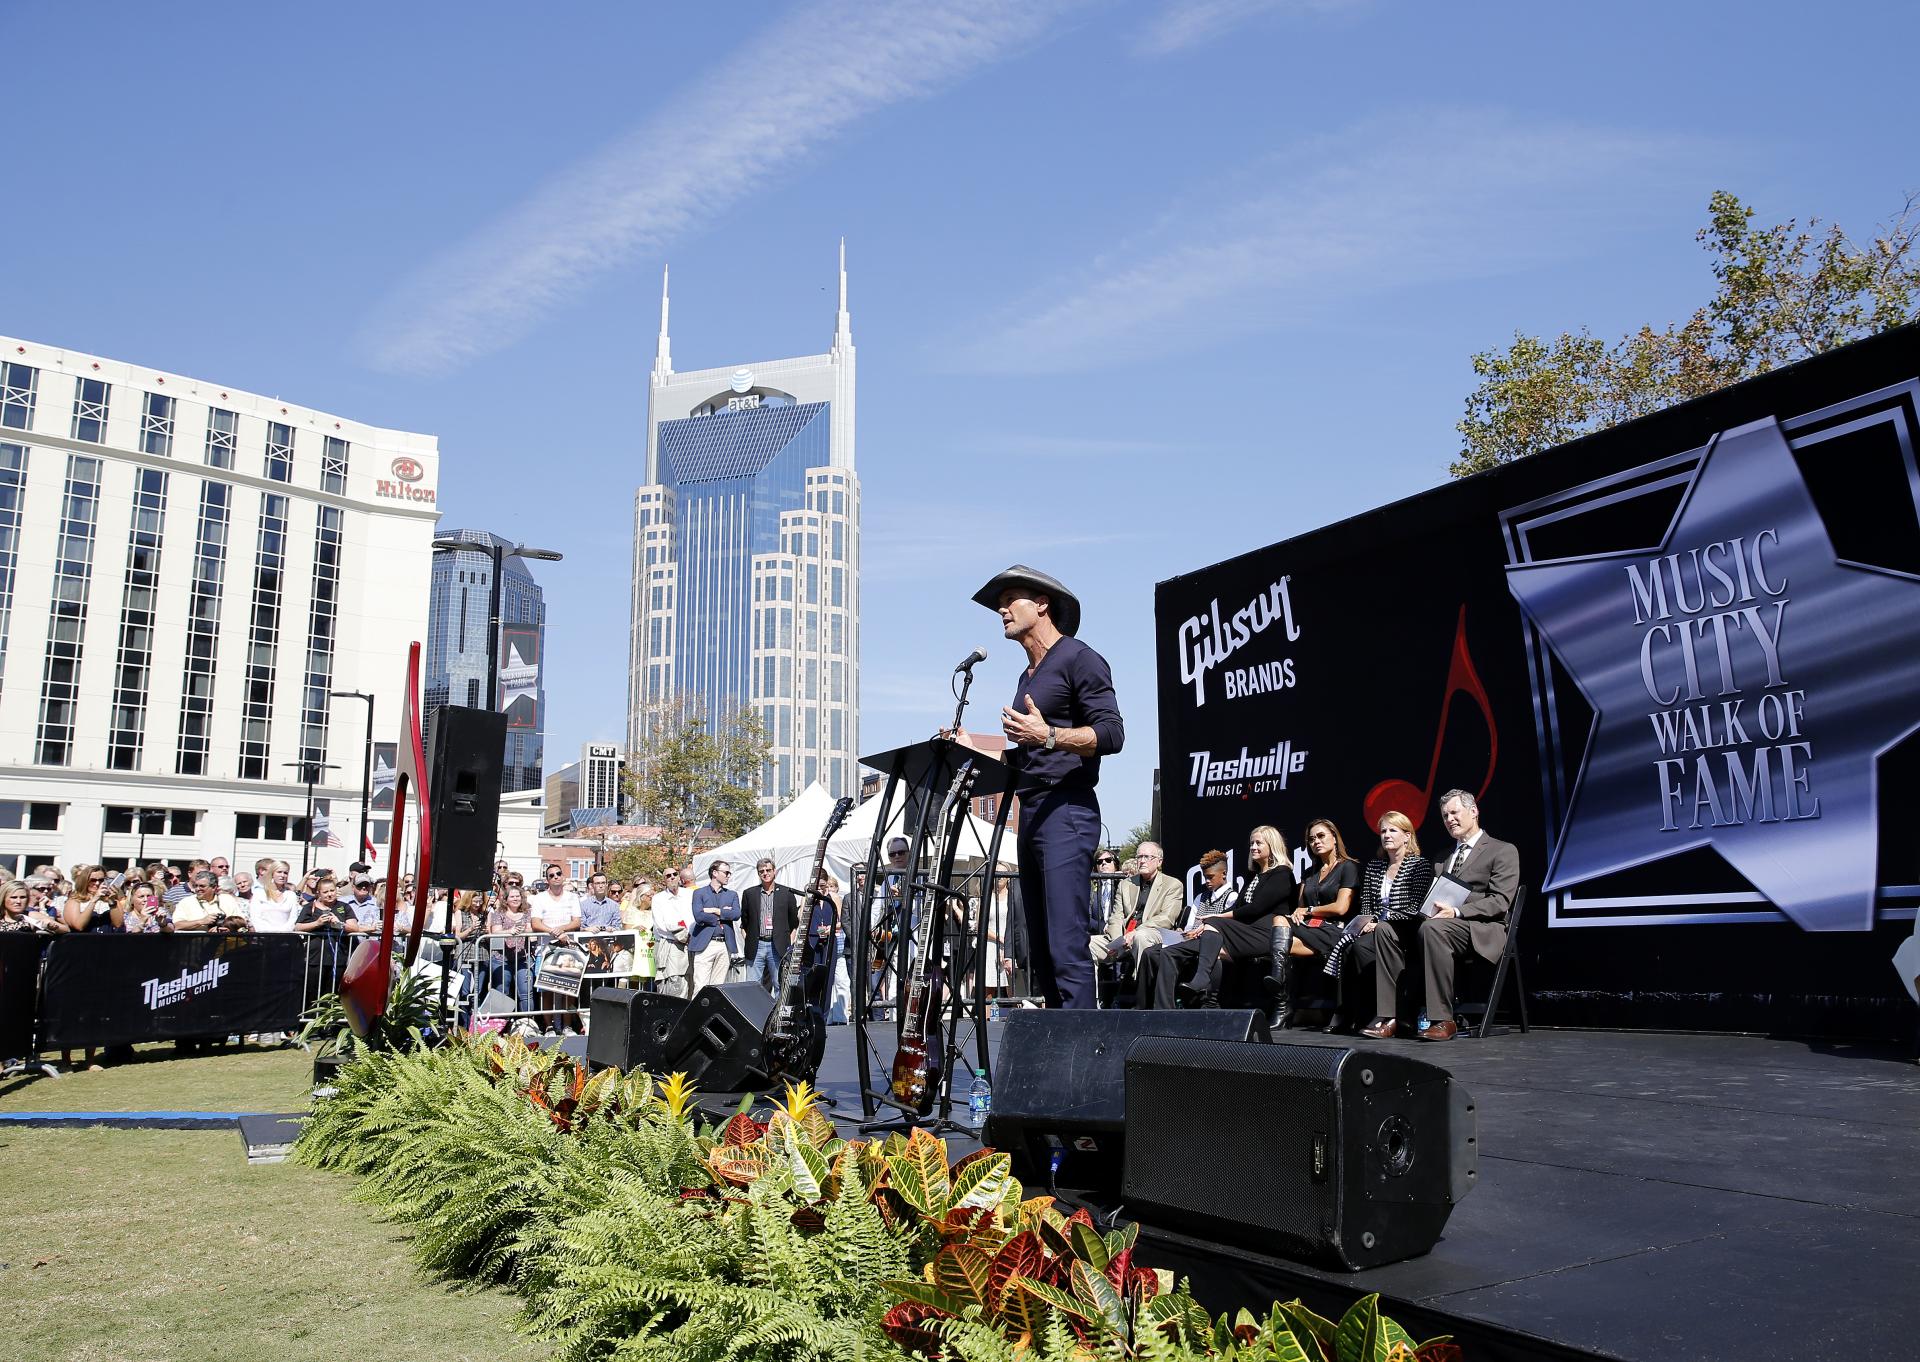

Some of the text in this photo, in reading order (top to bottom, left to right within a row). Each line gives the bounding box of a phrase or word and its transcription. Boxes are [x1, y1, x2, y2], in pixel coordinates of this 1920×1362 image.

[730, 396, 757, 411] at&t
[376, 480, 435, 503] Hilton
[1624, 528, 1787, 625] MUSIC
[1179, 576, 1300, 707] Gibson
[1640, 599, 1790, 706] CITY
[1225, 658, 1296, 699] BRANDS
[1648, 690, 1805, 755] WALK OF
[592, 747, 613, 756] CMT
[1189, 740, 1305, 797] Nashville
[1206, 780, 1279, 797] MUSIC CITY
[1653, 742, 1821, 831] FAME
[141, 958, 229, 1010] Nashville
[158, 982, 212, 1008] MUSIC CITY
